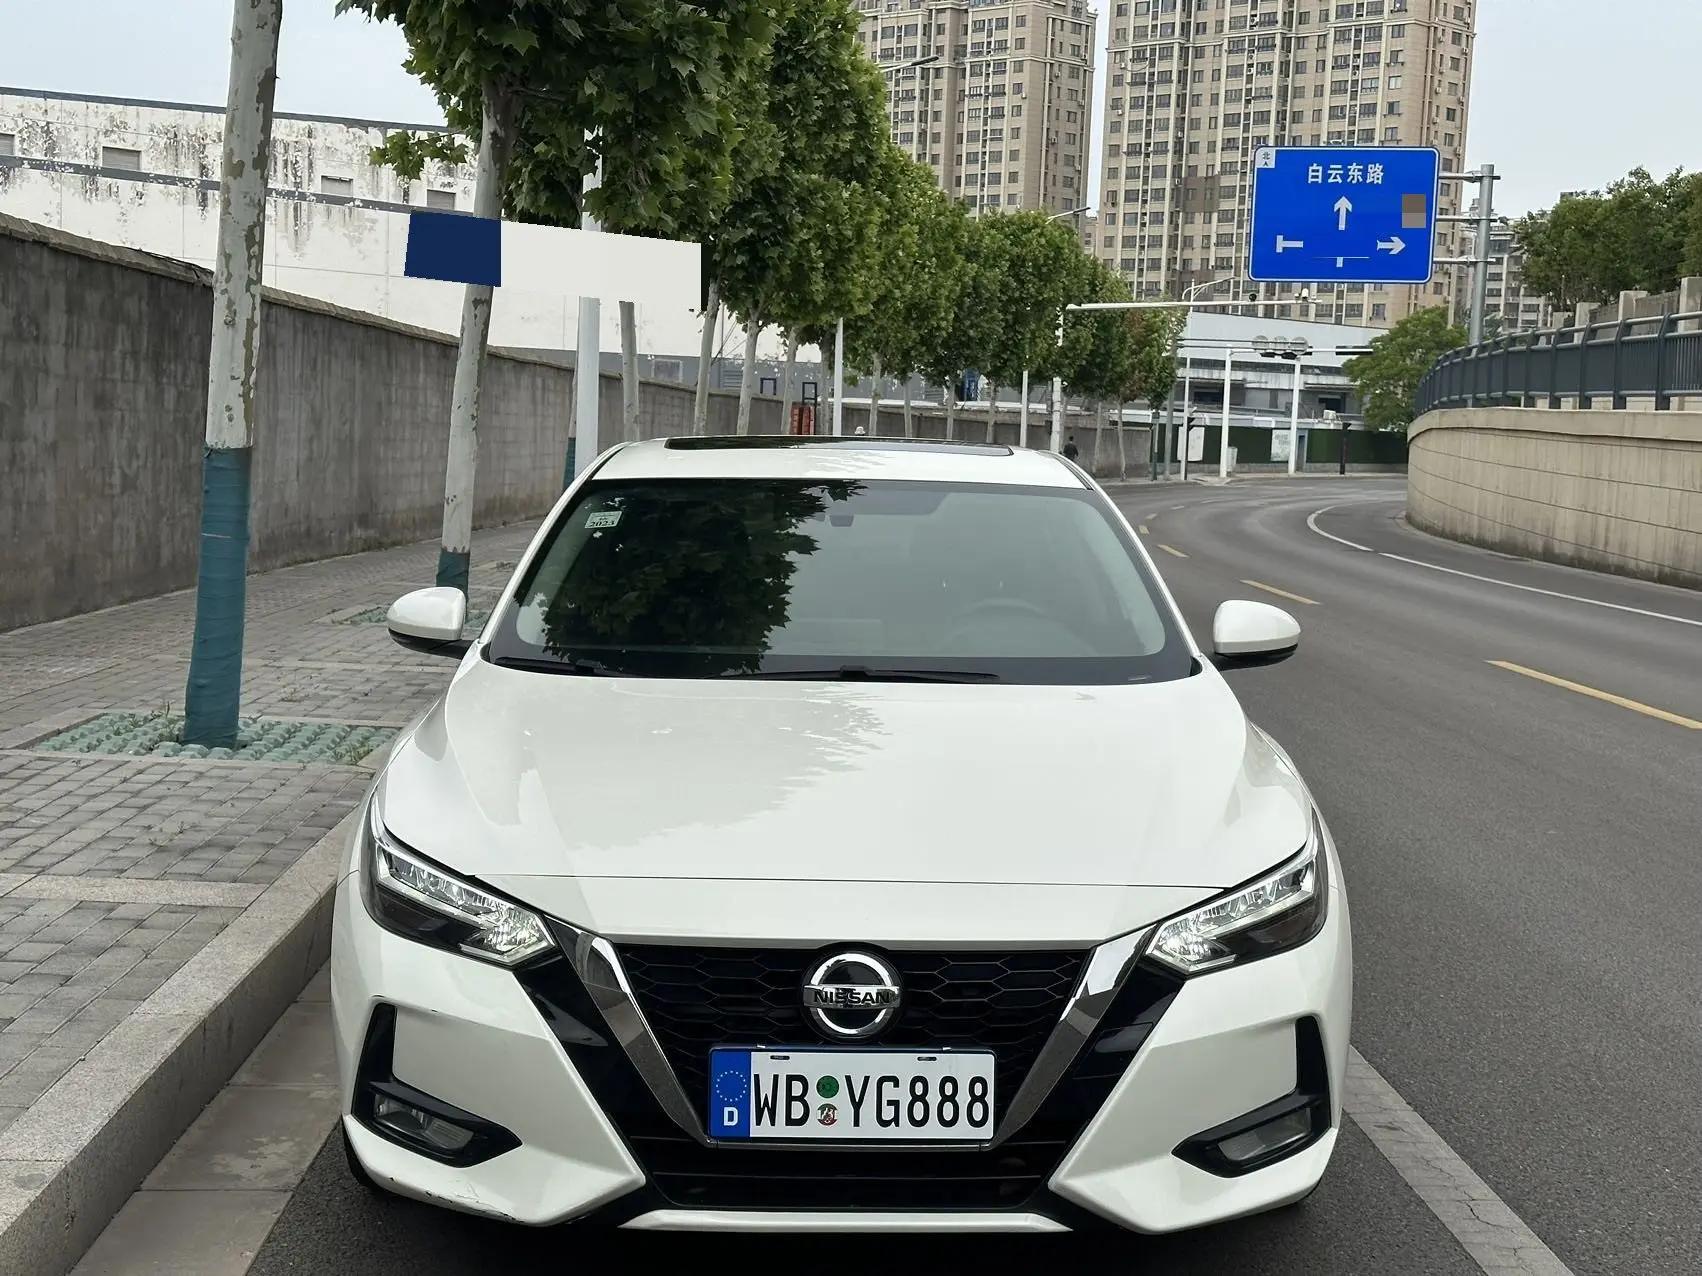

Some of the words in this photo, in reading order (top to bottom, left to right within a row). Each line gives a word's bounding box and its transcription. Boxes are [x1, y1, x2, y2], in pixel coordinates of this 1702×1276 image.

[1262, 151, 1271, 160] 北
[1307, 163, 1384, 184] 白云东路
[814, 991, 890, 1004] NISSAN
[753, 1073, 810, 1127] WB
[844, 1074, 990, 1128] YG888
[723, 1106, 739, 1126] D
